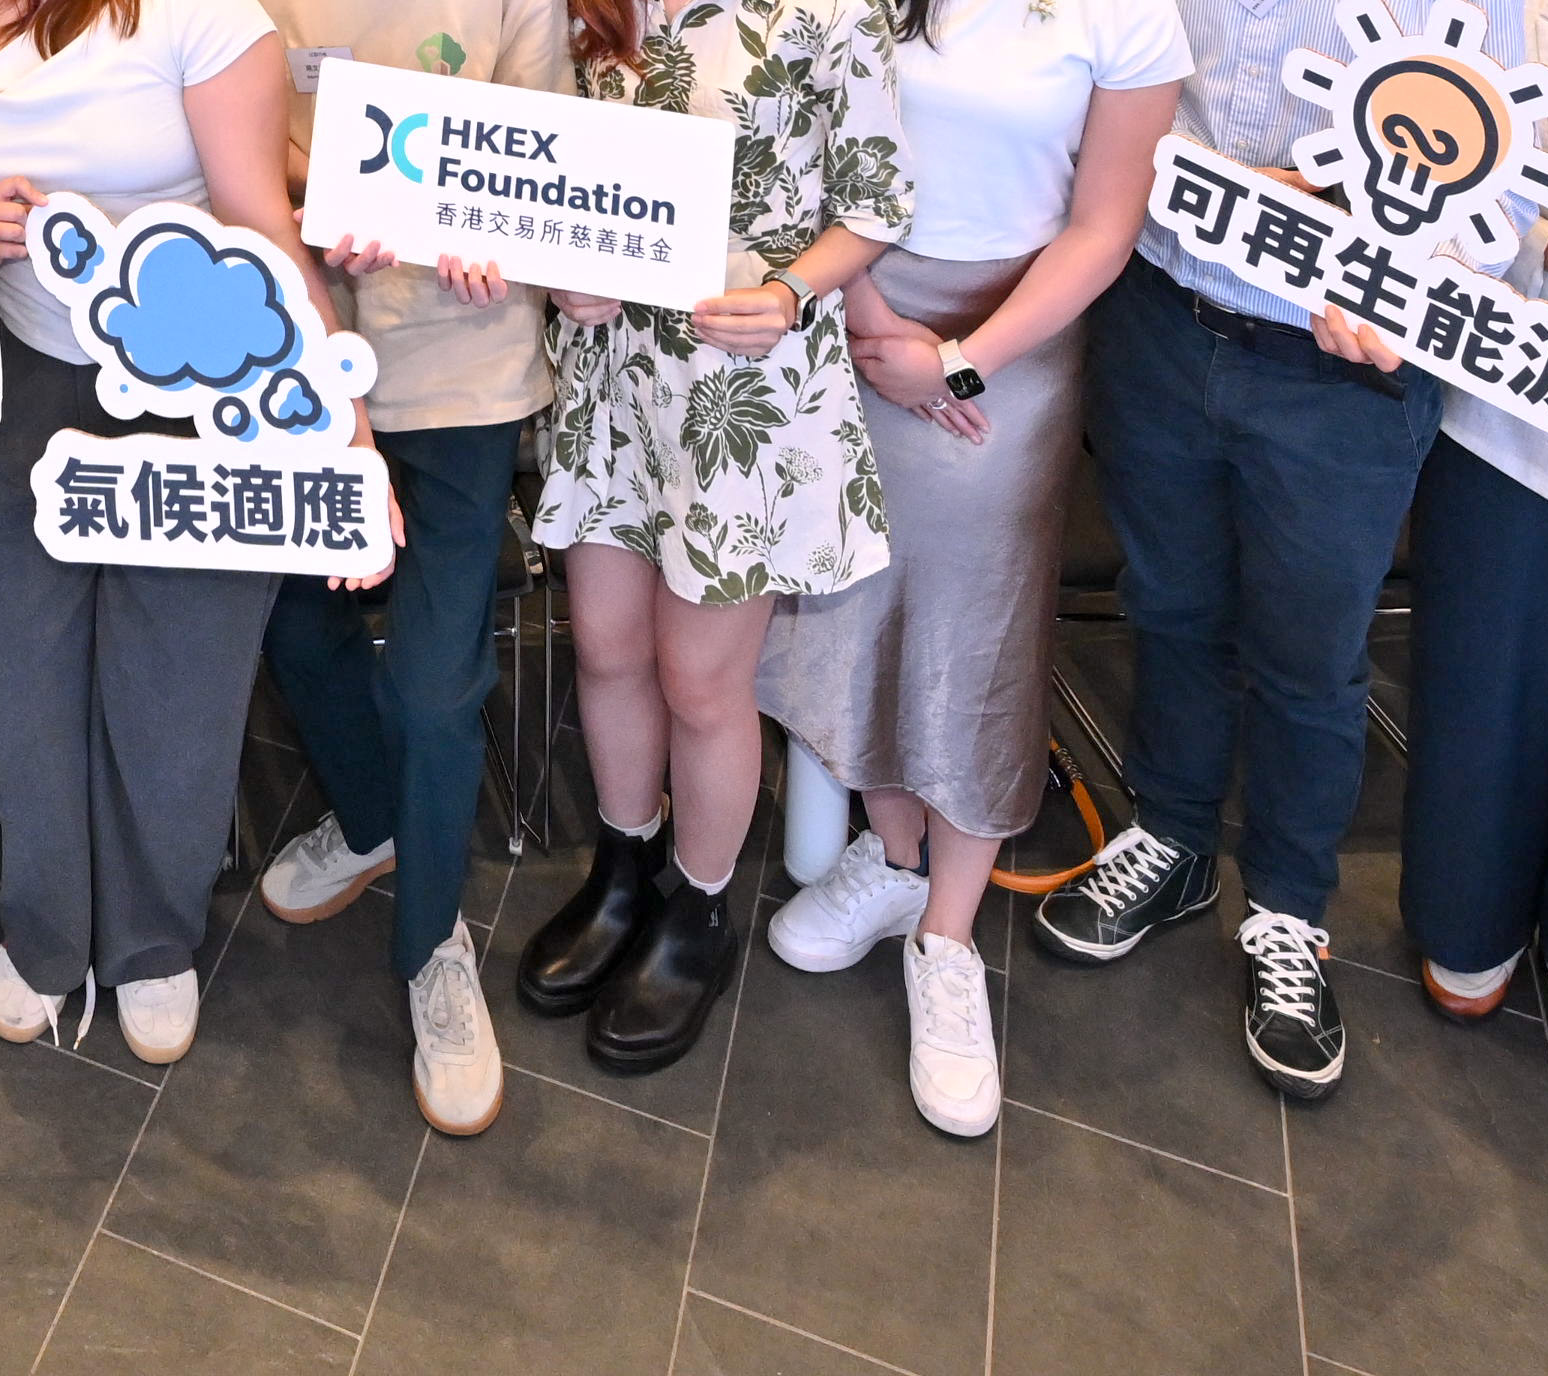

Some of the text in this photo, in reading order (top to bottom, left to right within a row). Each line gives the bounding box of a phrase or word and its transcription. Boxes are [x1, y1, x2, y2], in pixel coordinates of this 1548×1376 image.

[441, 115, 560, 164] HKEX
[437, 156, 677, 226] Foundation
[435, 201, 673, 264] 香港交易所慈善基金
[55, 456, 370, 551] 氣候適應
